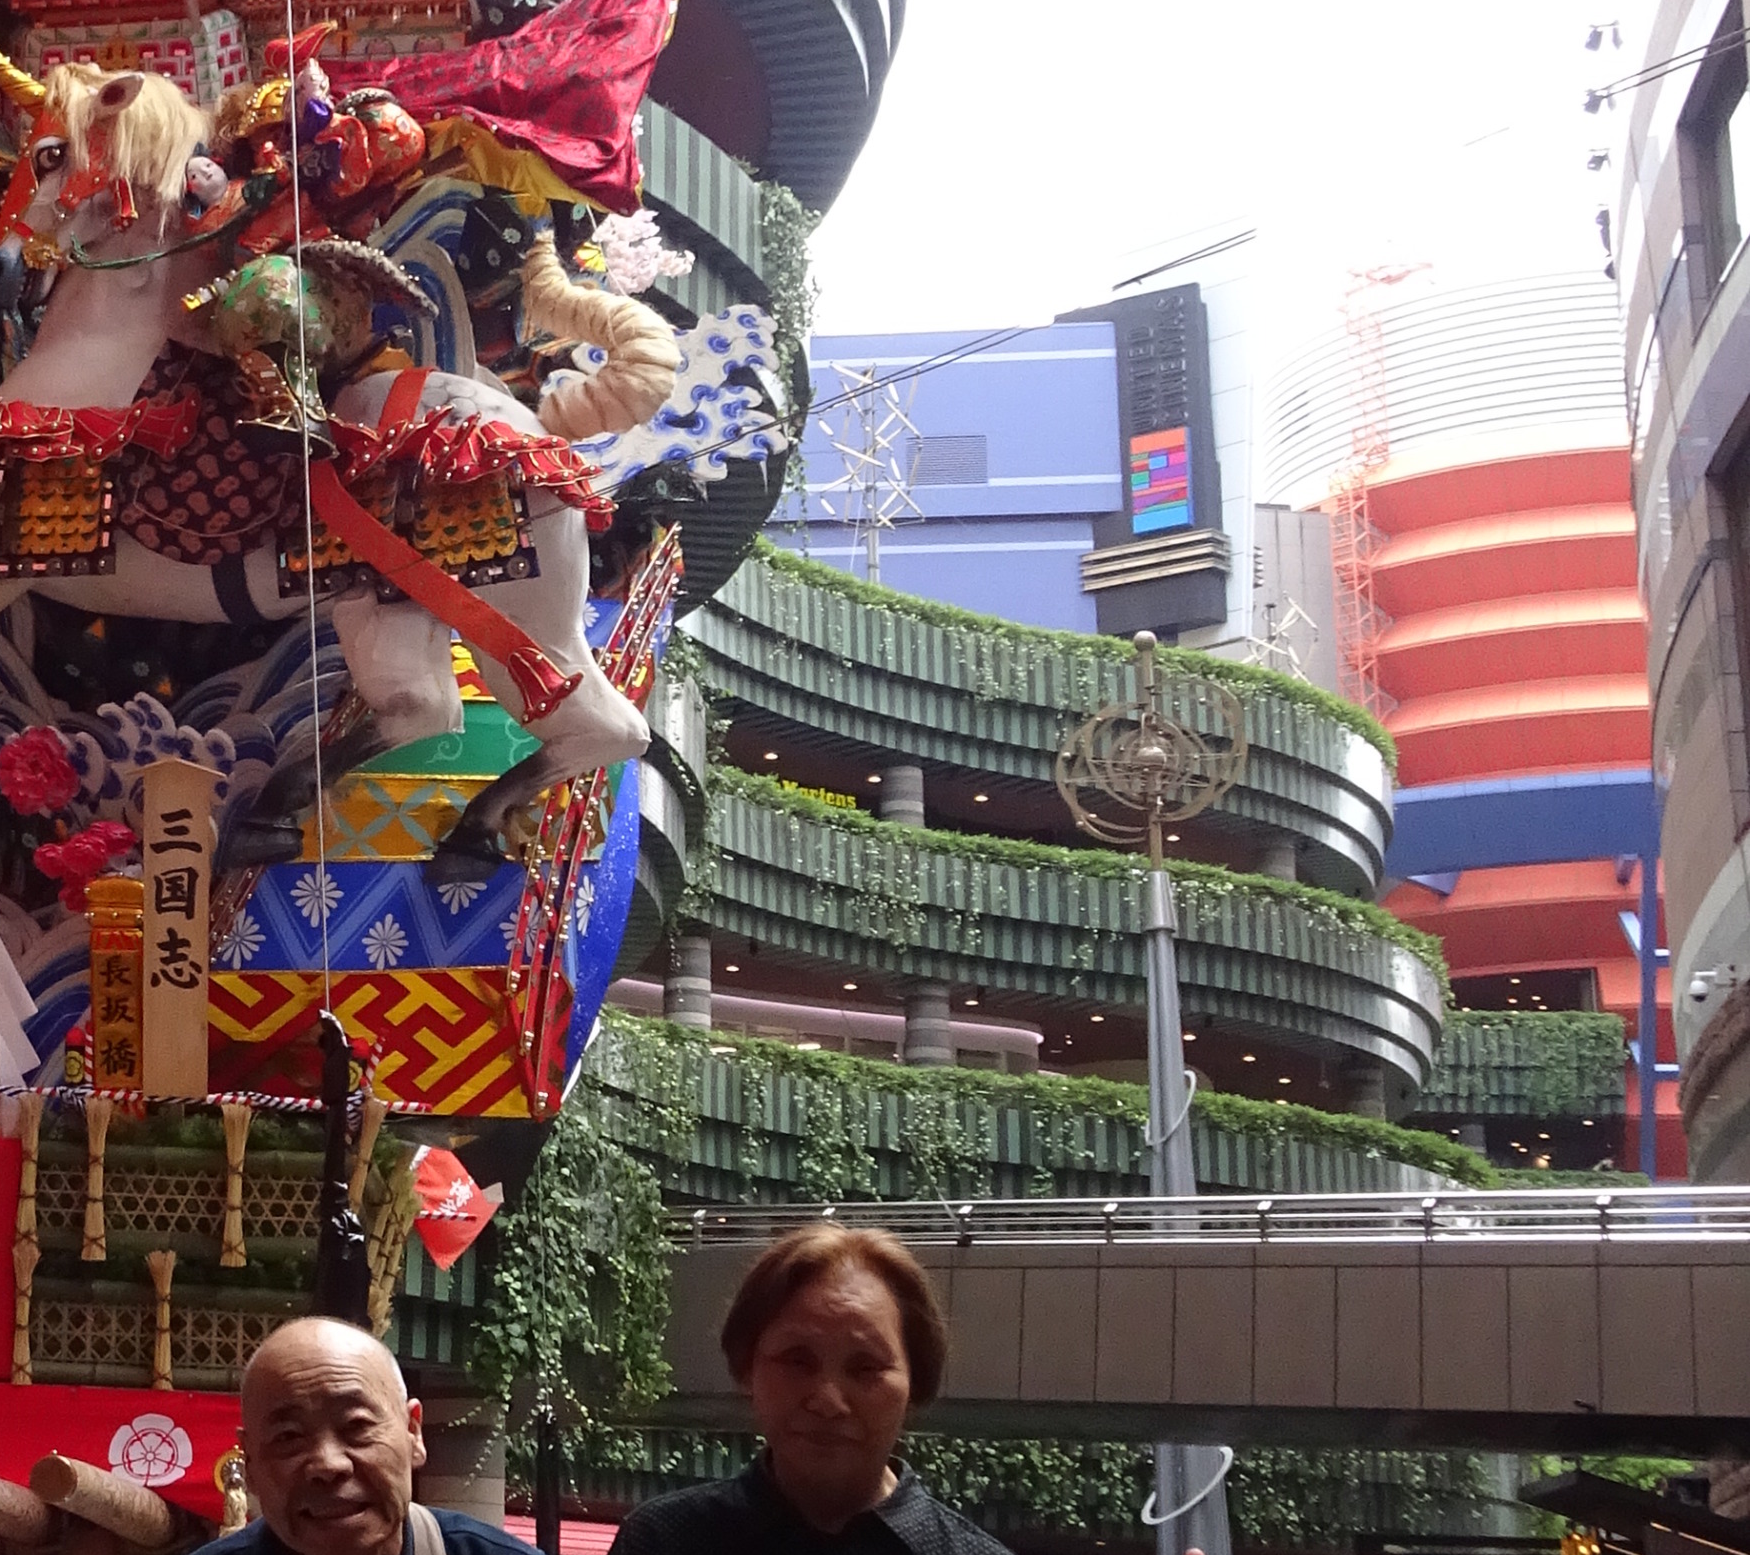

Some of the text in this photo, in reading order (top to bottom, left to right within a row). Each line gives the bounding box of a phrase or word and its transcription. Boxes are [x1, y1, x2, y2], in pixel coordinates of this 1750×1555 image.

[150, 808, 203, 990] 三国志
[100, 954, 137, 1078] 長坂橋
